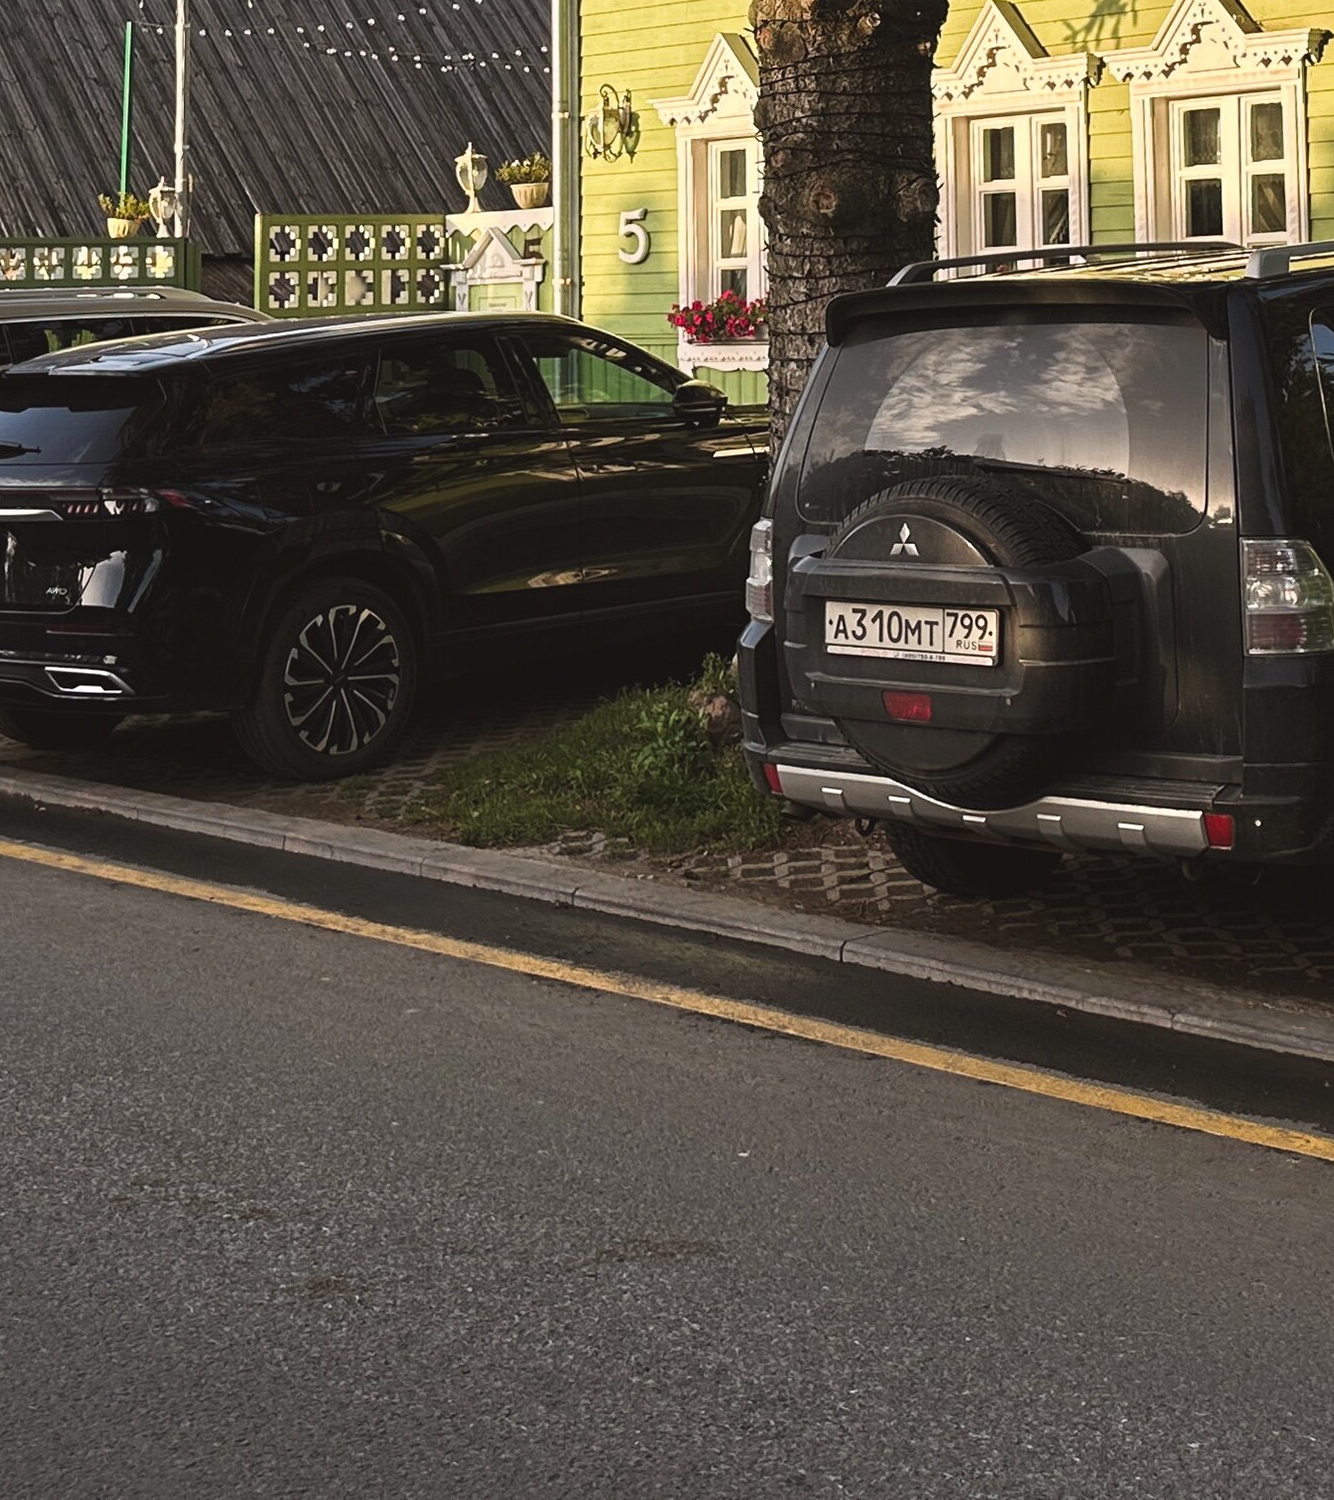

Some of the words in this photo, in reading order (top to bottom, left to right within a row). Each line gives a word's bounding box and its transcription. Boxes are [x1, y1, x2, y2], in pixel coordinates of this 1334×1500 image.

[618, 207, 651, 265] 5
[833, 607, 939, 646] А310МТ
[946, 611, 989, 641] 799
[955, 638, 978, 651] RUS
